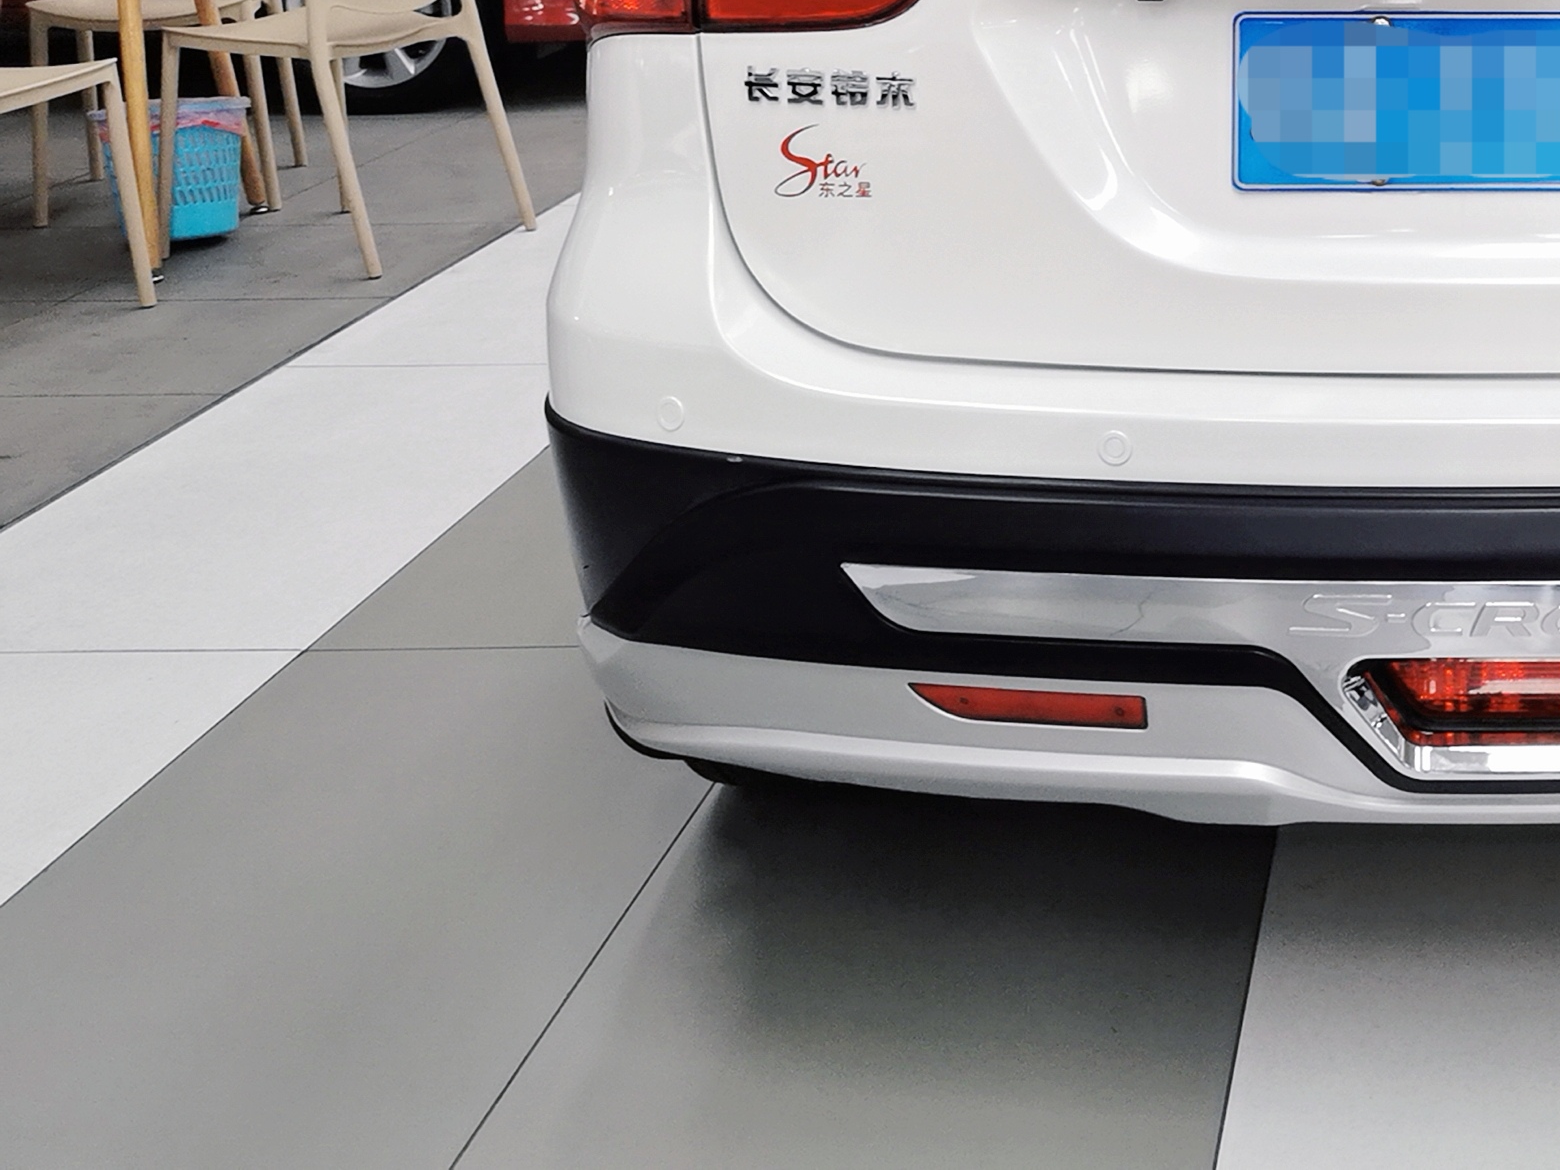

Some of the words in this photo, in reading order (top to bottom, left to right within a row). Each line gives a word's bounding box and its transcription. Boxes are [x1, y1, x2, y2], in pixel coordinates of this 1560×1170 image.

[744, 66, 916, 108] 长安铃木
[774, 124, 867, 198] Star
[818, 181, 872, 198] 东之星
